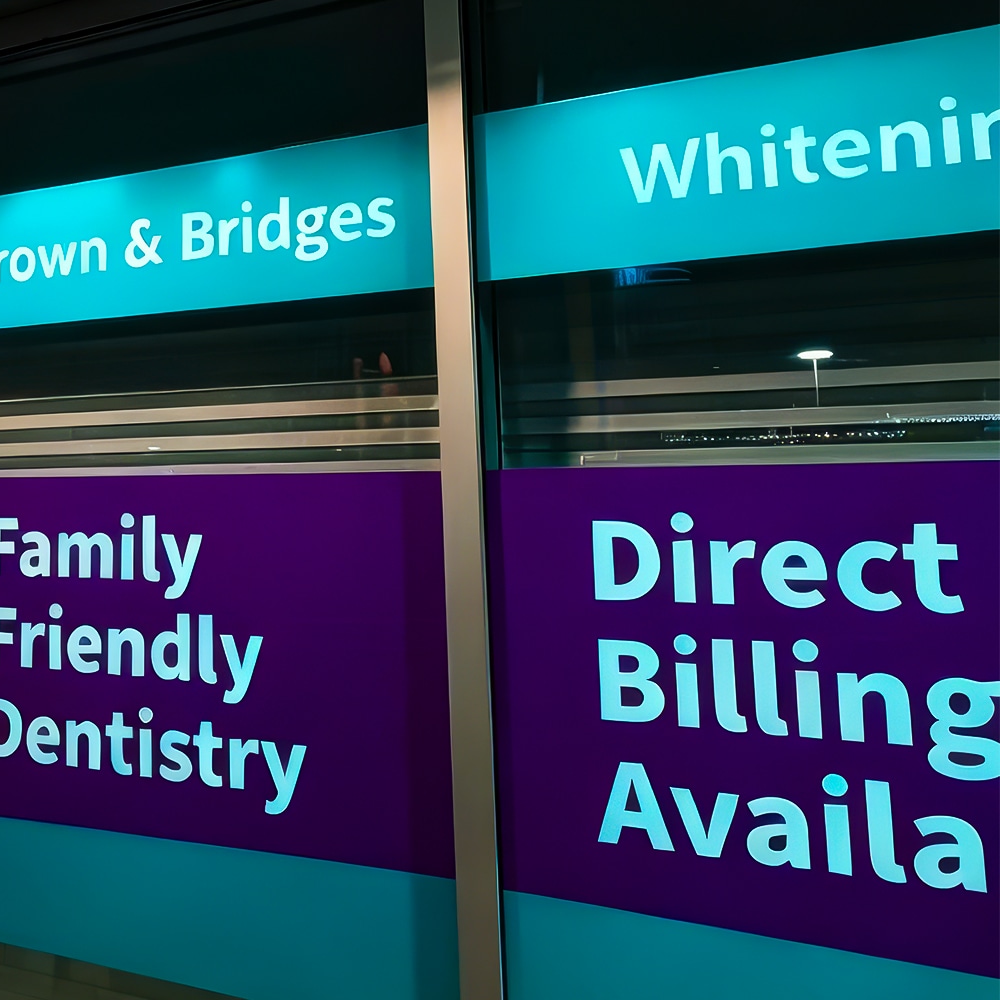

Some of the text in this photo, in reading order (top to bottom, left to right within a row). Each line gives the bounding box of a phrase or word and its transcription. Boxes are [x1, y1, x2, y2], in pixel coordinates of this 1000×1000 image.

[124, 218, 163, 268] &
[182, 196, 396, 261] Bridges
[592, 511, 965, 614] Direct
[598, 634, 1000, 781] Billing
[598, 762, 988, 893] Availa
